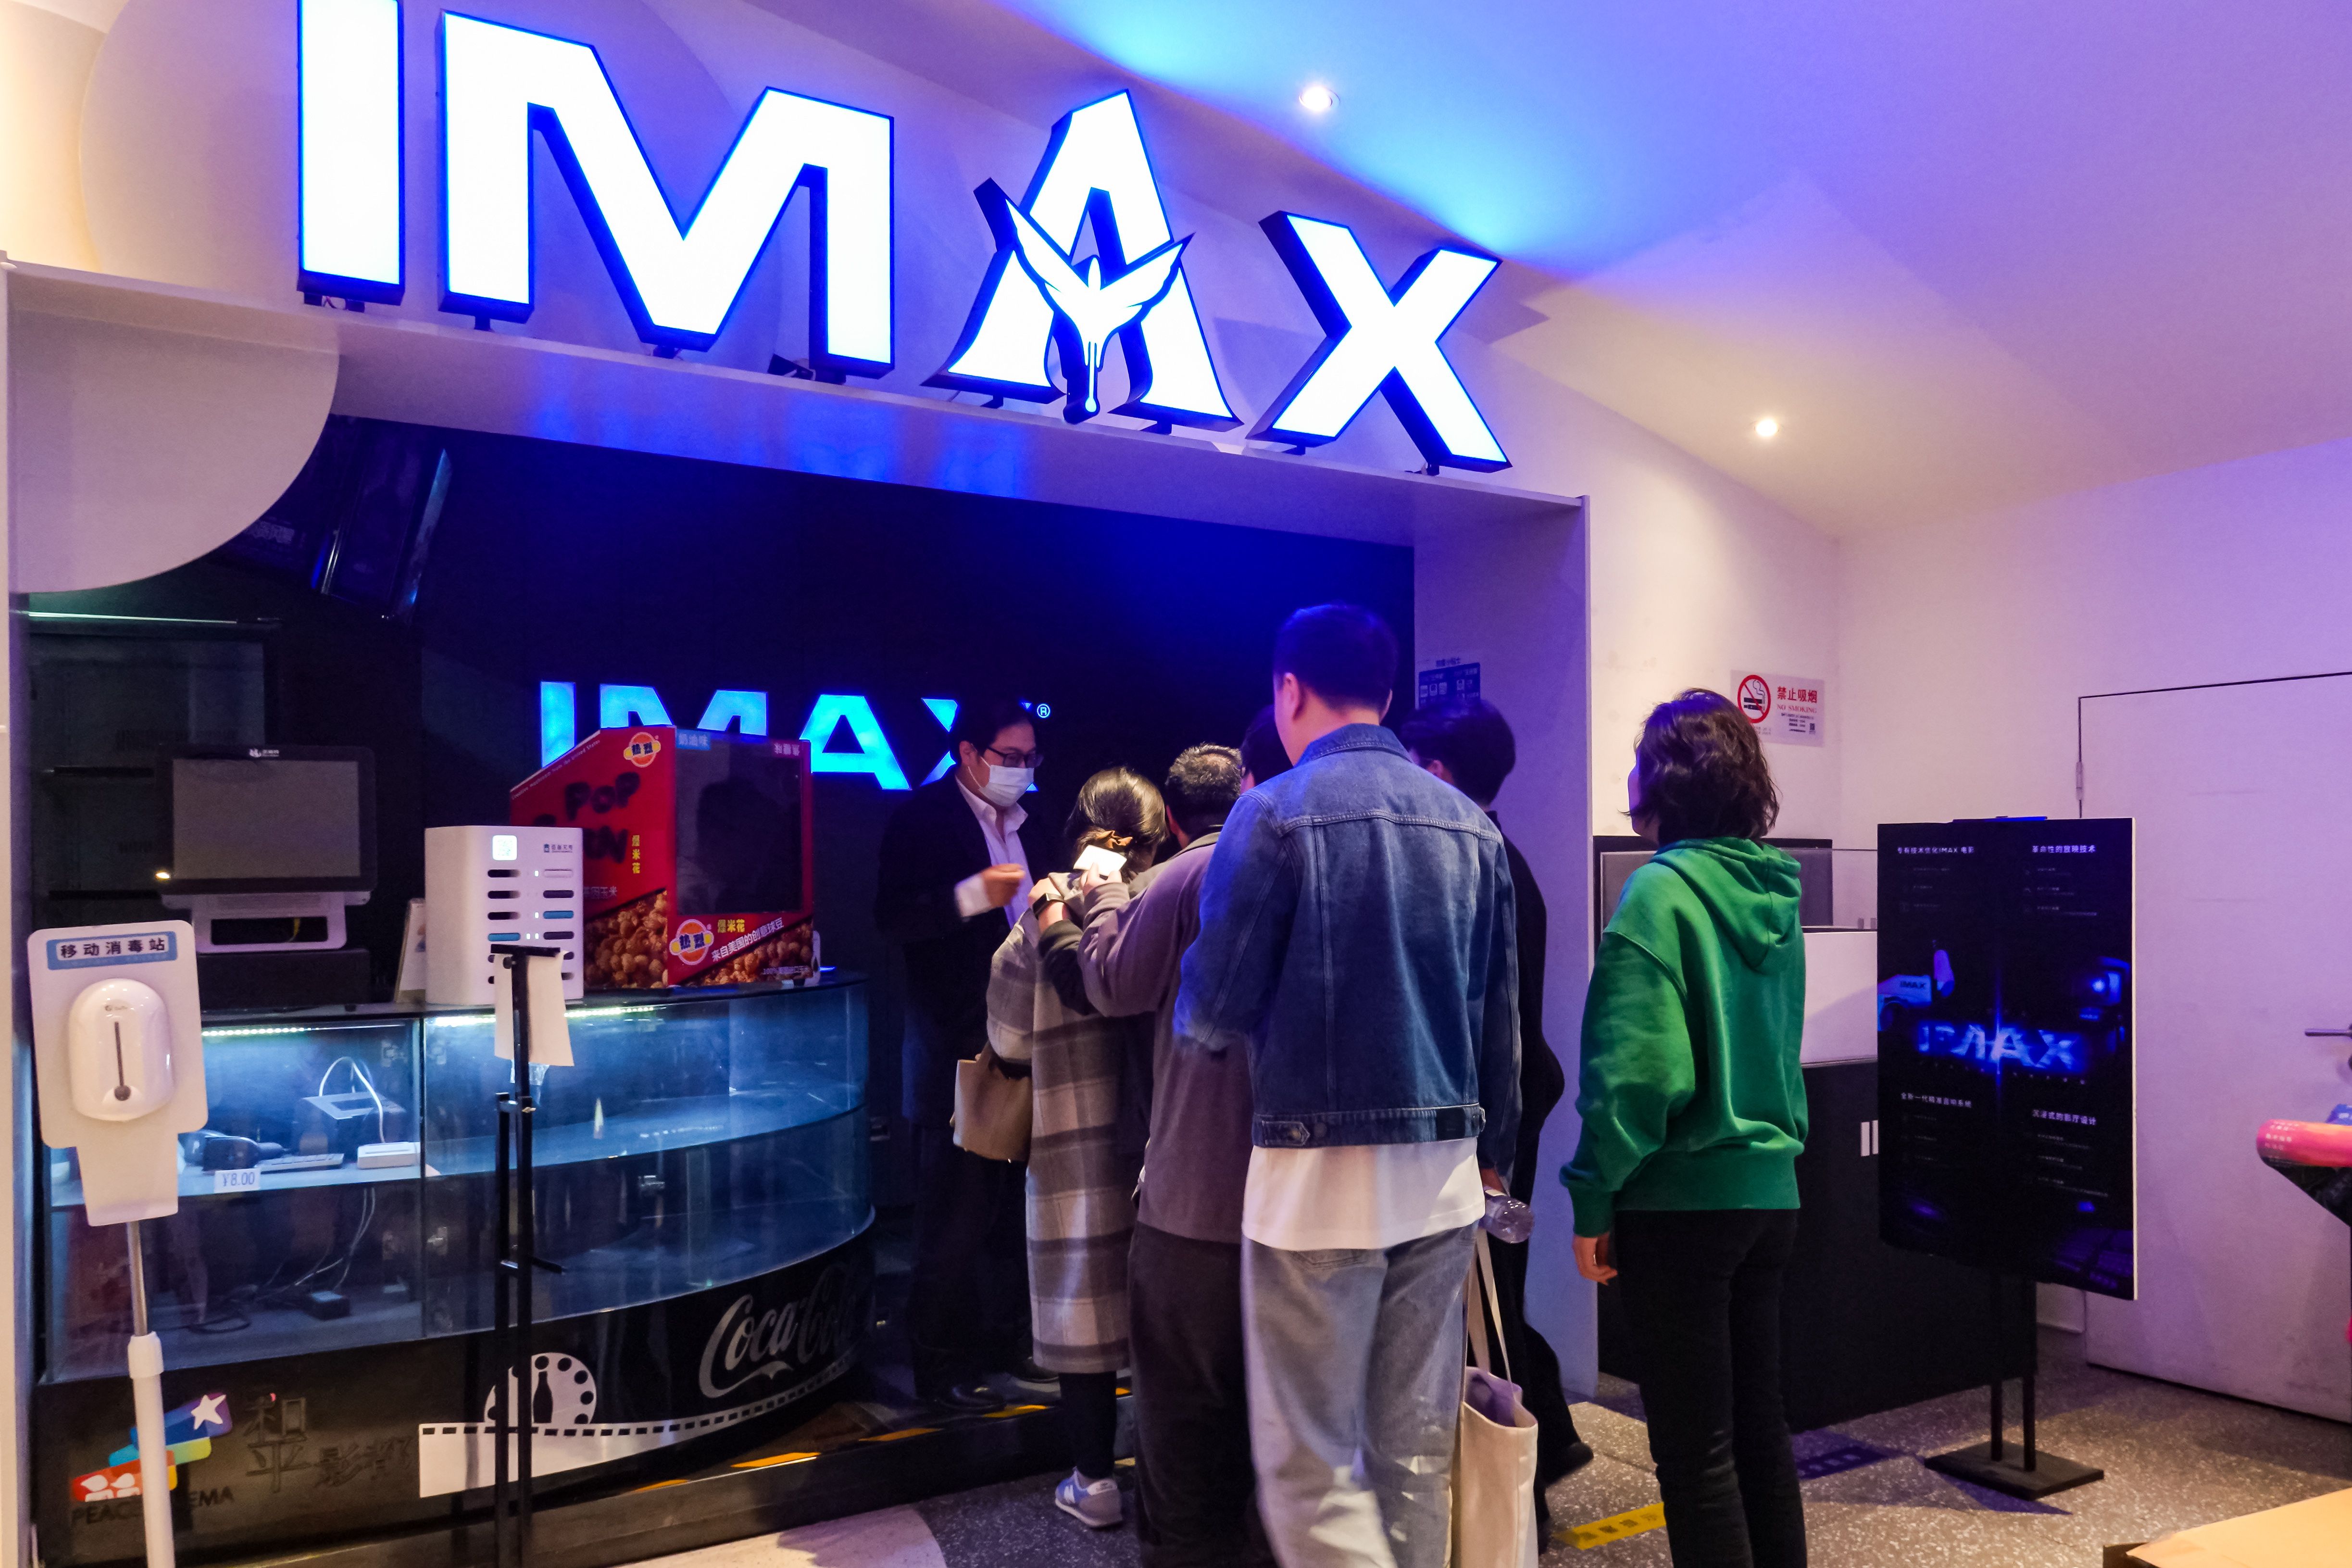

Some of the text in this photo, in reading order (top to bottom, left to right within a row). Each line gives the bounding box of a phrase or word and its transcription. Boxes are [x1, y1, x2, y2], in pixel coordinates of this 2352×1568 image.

[297, 0, 1512, 470] IMAX
[1777, 686, 1817, 703] 禁止吸烟
[1788, 705, 1817, 714] SMOKING
[61, 938, 165, 958] 移动消毒站
[711, 917, 784, 962] 来自美国的创意球豆
